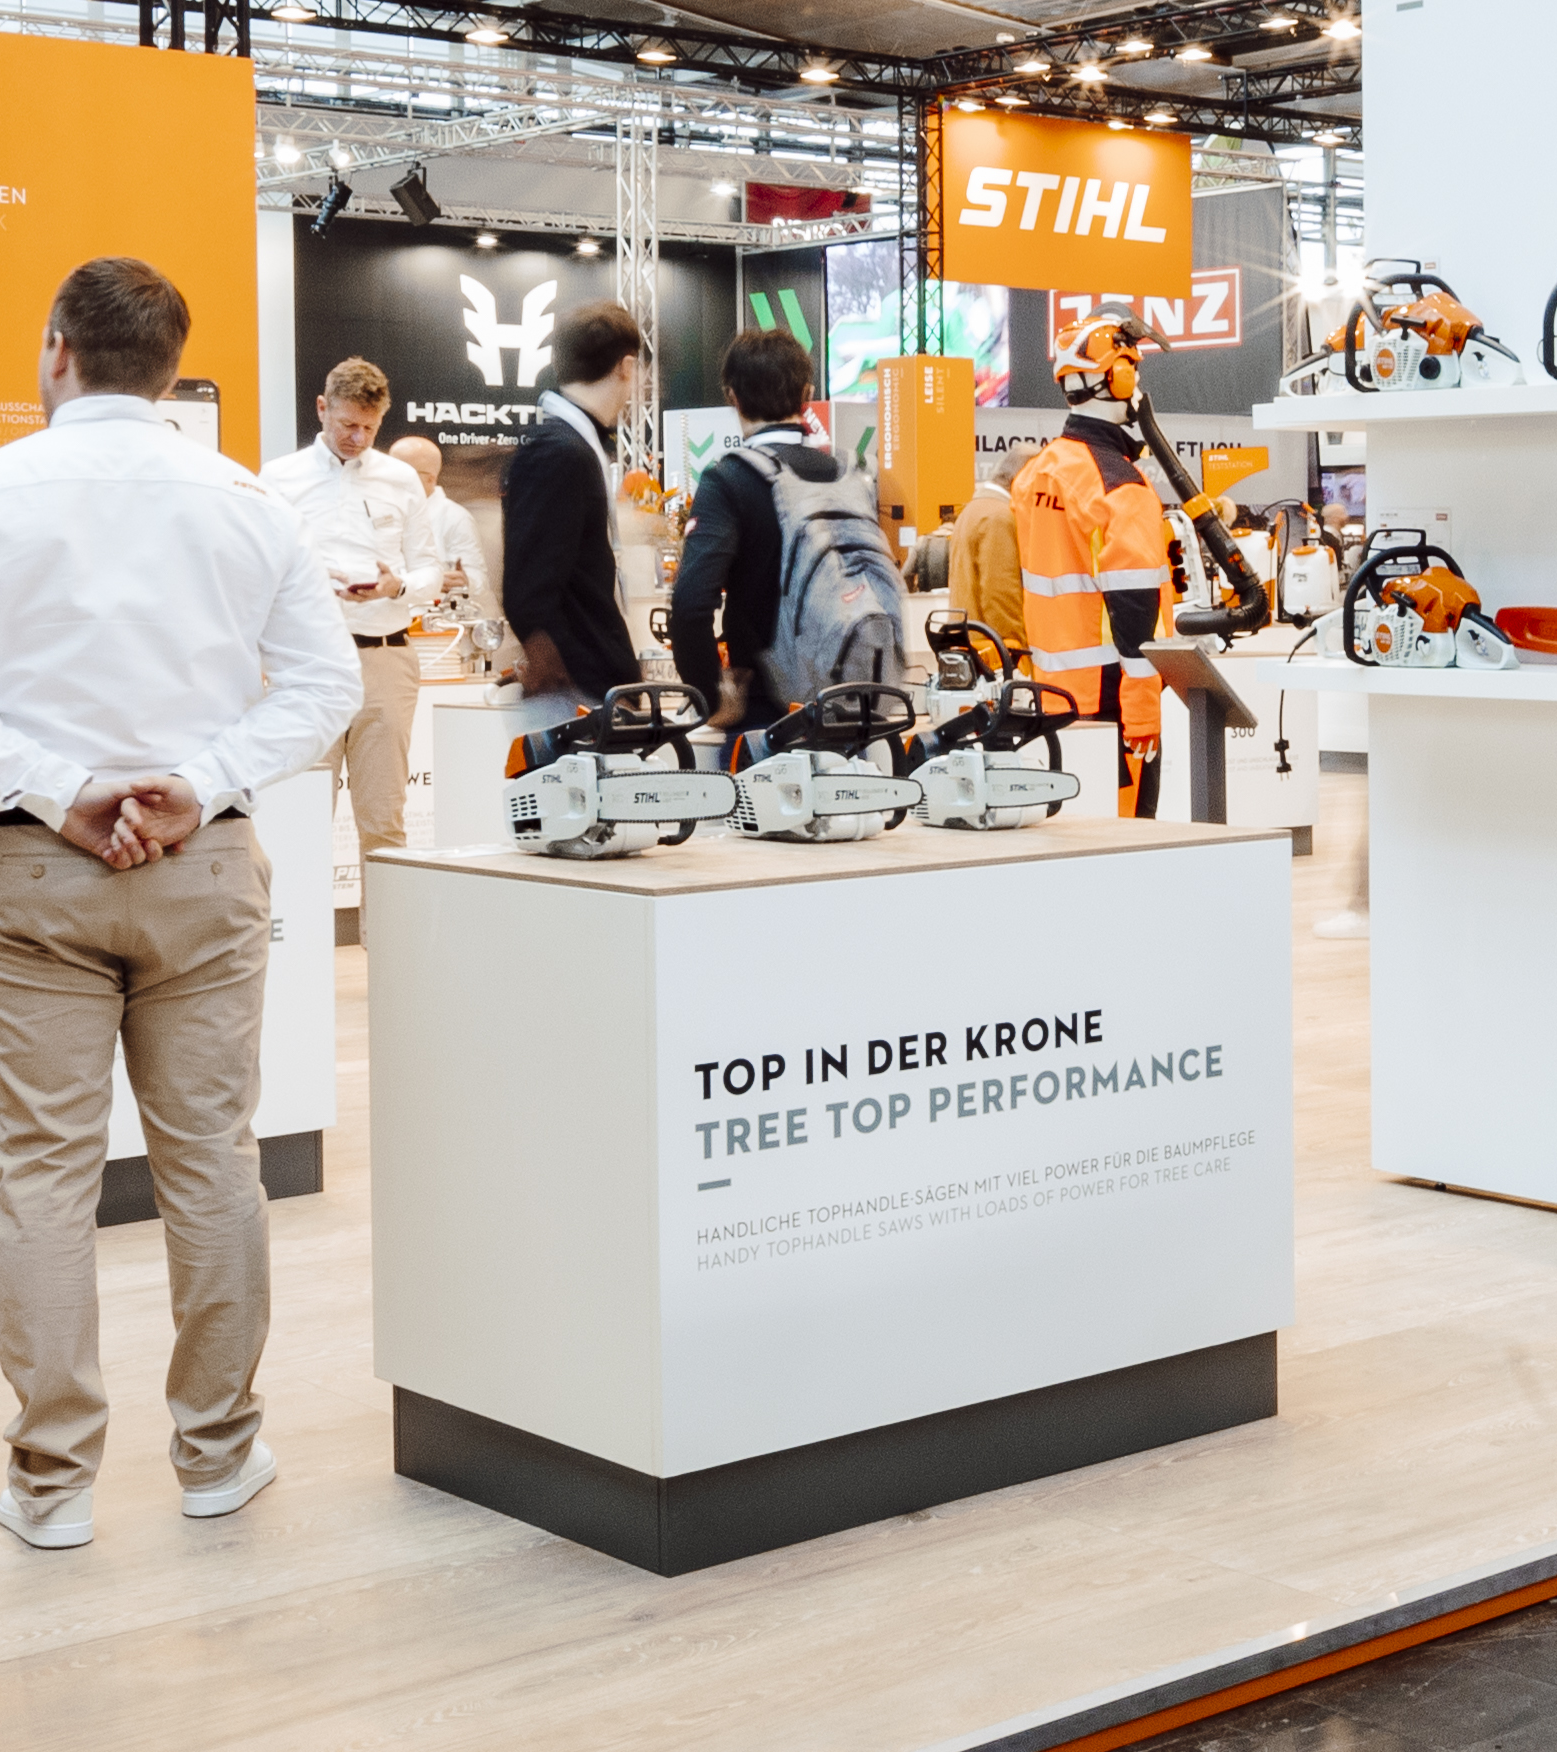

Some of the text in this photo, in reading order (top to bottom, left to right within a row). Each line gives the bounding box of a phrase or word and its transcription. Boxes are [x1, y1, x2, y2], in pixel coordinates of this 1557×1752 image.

[958, 166, 1168, 244] STIHL
[924, 366, 934, 404] LEISE
[883, 368, 892, 469] ERGONOMISCH
[438, 432, 461, 446] One
[460, 432, 490, 447] Driver
[542, 773, 562, 784] STIHL
[753, 773, 772, 784] STIHL
[929, 765, 949, 775] STIHL
[633, 791, 661, 804] STIHL
[834, 789, 860, 801] STIHL
[1009, 783, 1028, 792] STIHL
[695, 1009, 1104, 1100] TOP IN DER KRONE
[695, 1044, 1225, 1160] TREE TOP PERFORMANCE
[697, 1129, 1256, 1245] HANDLICHE TOPHANDLE-SÄGEN MIT VIEL POWER FÜR DIE BAUMPFLEGE
[697, 1156, 1231, 1270] HANDY TOPHANDLE SAWS WITH LOADS OF POWER FOR TREE CARE
